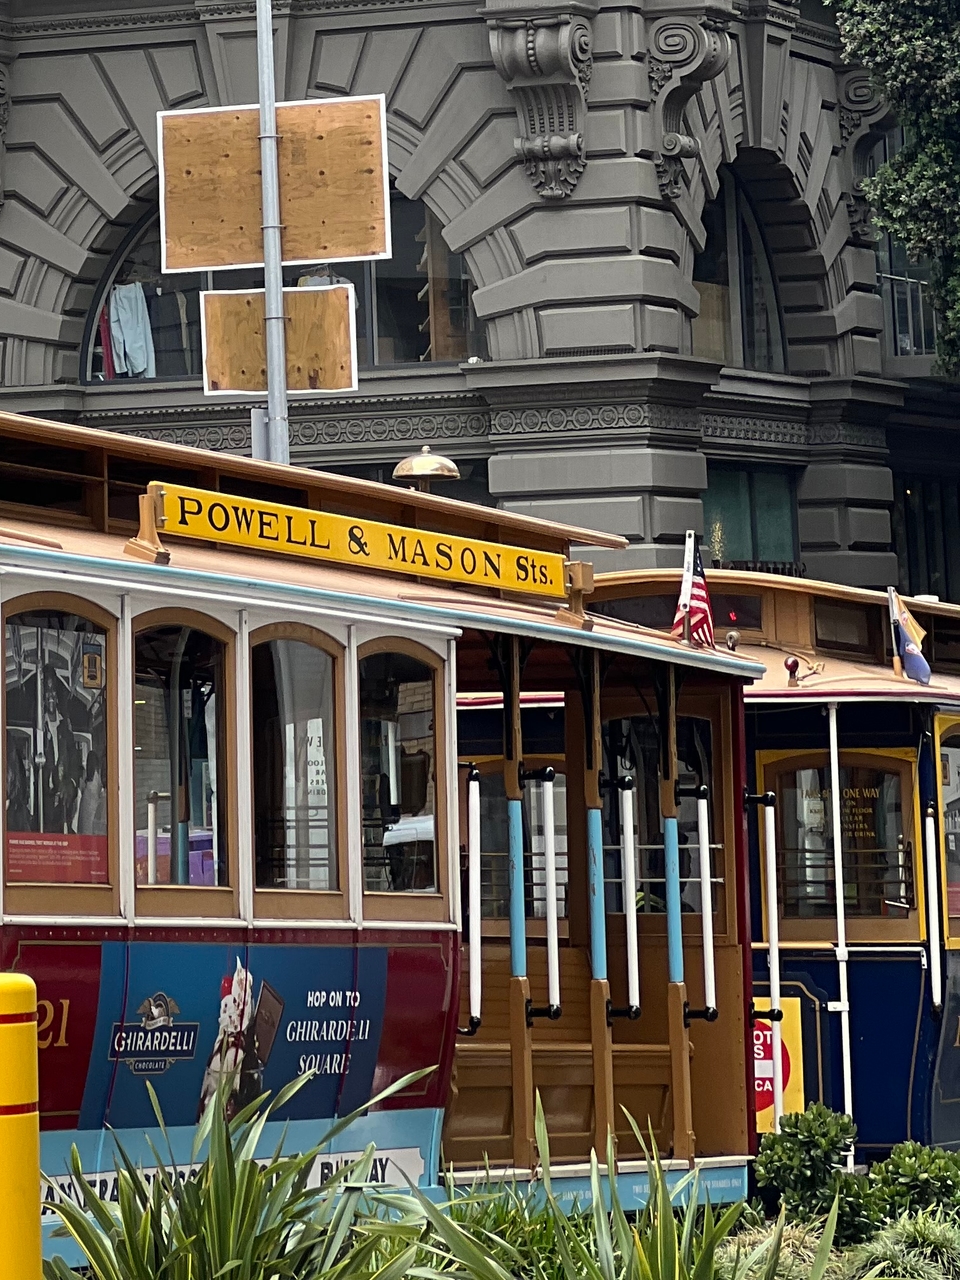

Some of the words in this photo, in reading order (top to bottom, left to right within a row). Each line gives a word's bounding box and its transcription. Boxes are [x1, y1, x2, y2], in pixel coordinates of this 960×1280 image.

[177, 496, 330, 550] POWELL
[348, 525, 370, 556] &
[387, 533, 502, 579] MASON
[515, 555, 554, 586] Sts.
[843, 788, 860, 798] ONE
[863, 787, 880, 799] WAY
[307, 990, 327, 1008] HOP
[329, 990, 343, 1008] ON
[346, 990, 361, 1008] TO
[115, 1031, 195, 1052] GHIRARDELLI
[753, 1031, 773, 1045] OT
[134, 1060, 166, 1071] CHOCOLATE
